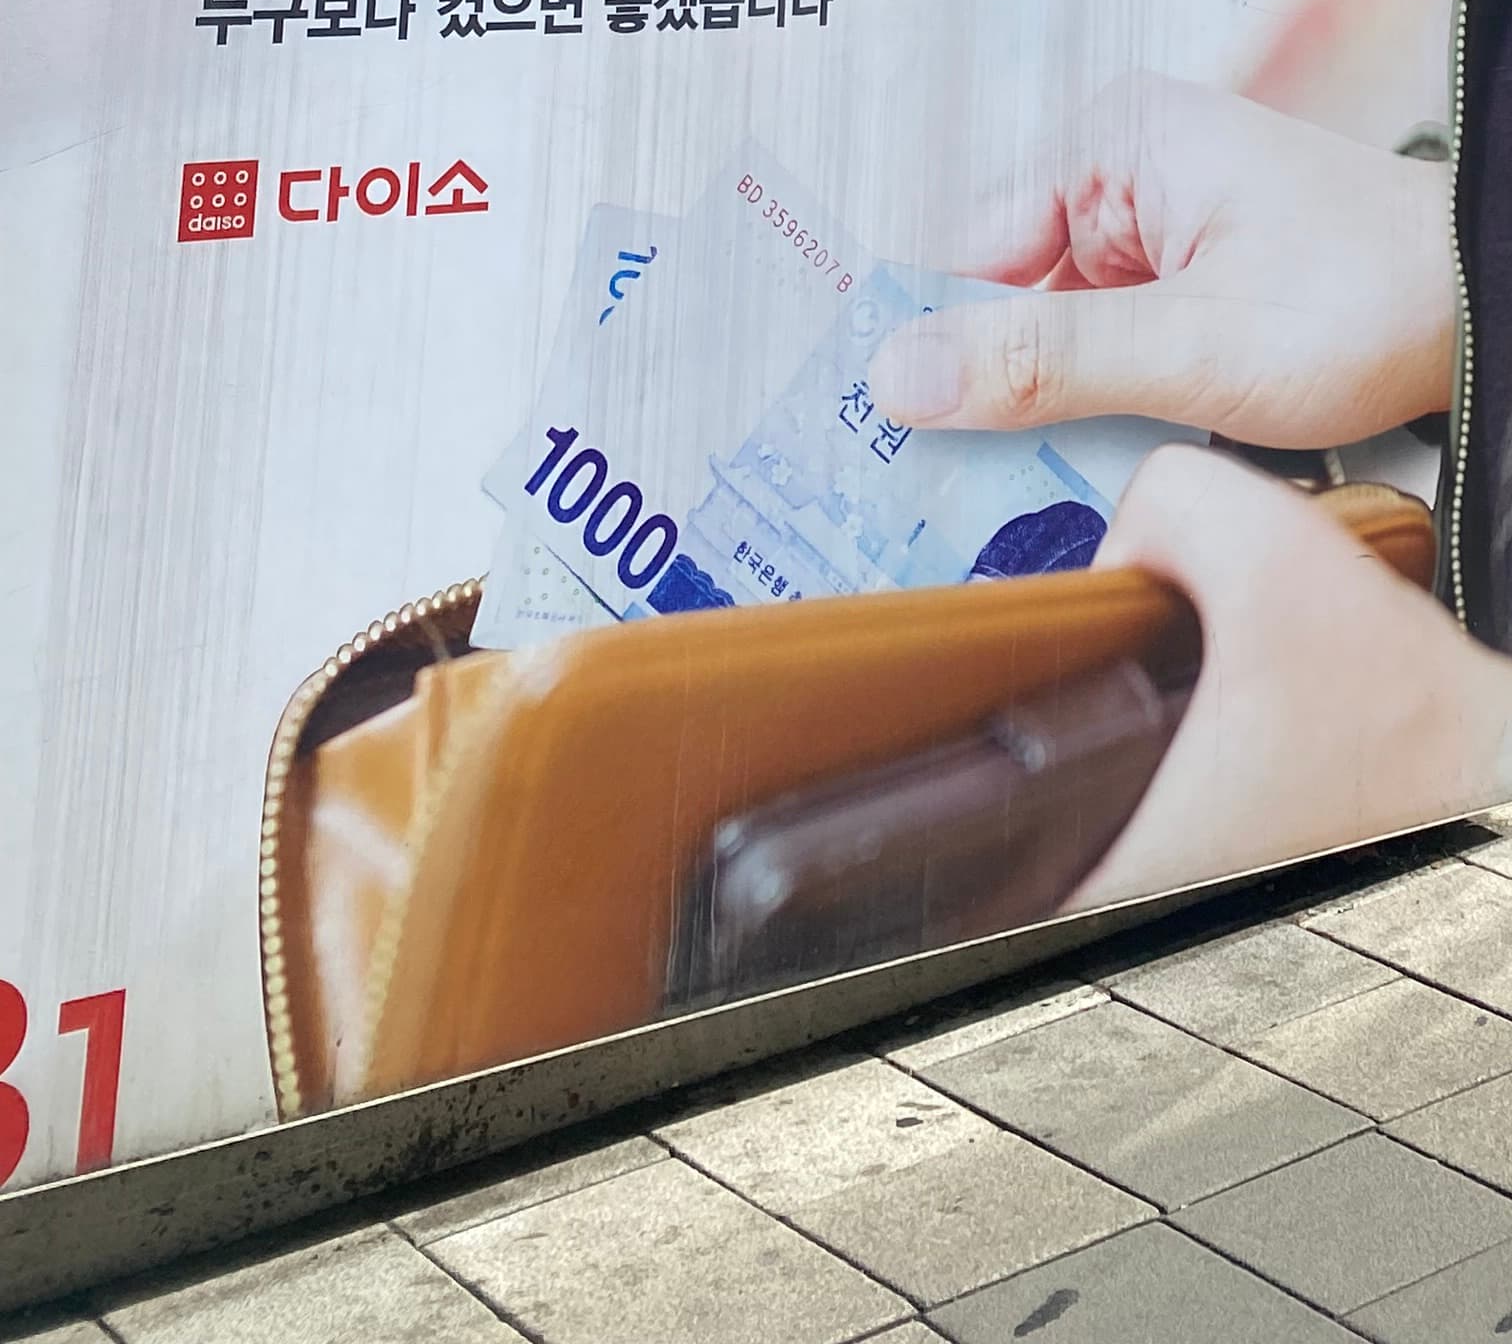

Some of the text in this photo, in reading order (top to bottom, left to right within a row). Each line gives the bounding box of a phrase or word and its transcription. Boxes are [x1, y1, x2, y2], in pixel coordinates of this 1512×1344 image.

[187, 210, 247, 236] daiso
[276, 157, 490, 224] 다이소
[736, 173, 765, 206] BD
[760, 197, 841, 278] 3596207
[522, 425, 680, 591] 1000
[733, 540, 790, 598] 한국은행
